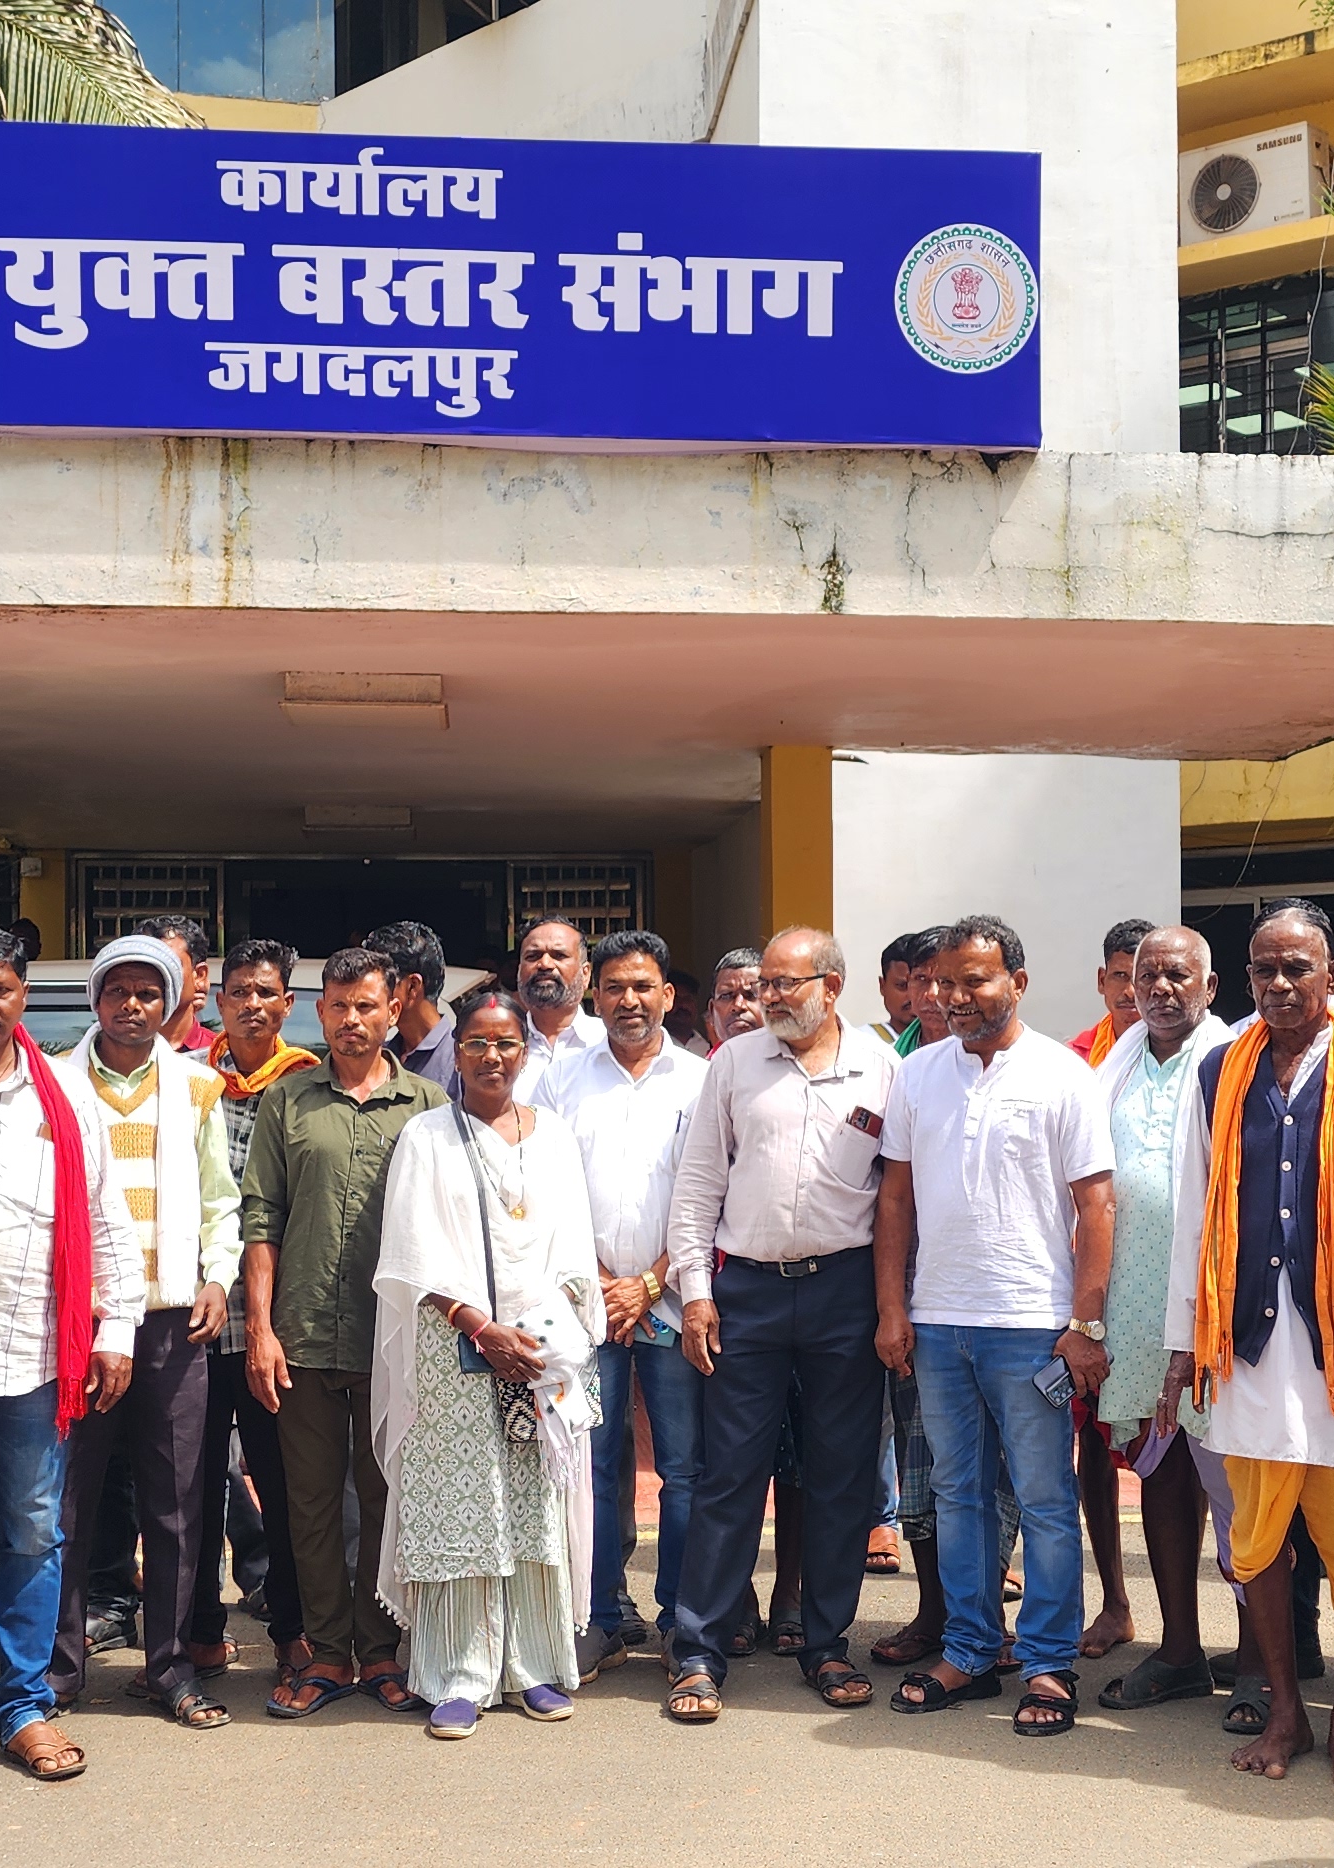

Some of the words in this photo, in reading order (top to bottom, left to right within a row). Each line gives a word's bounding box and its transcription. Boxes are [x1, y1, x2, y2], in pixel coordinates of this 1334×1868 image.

[1256, 133, 1303, 152] SAMSUNG
[216, 147, 503, 219] कार्यालय
[272, 244, 535, 329] बस्तर
[558, 232, 844, 337] संभाग
[980, 242, 1011, 268] शासन
[205, 341, 519, 418] जगदलपुर
